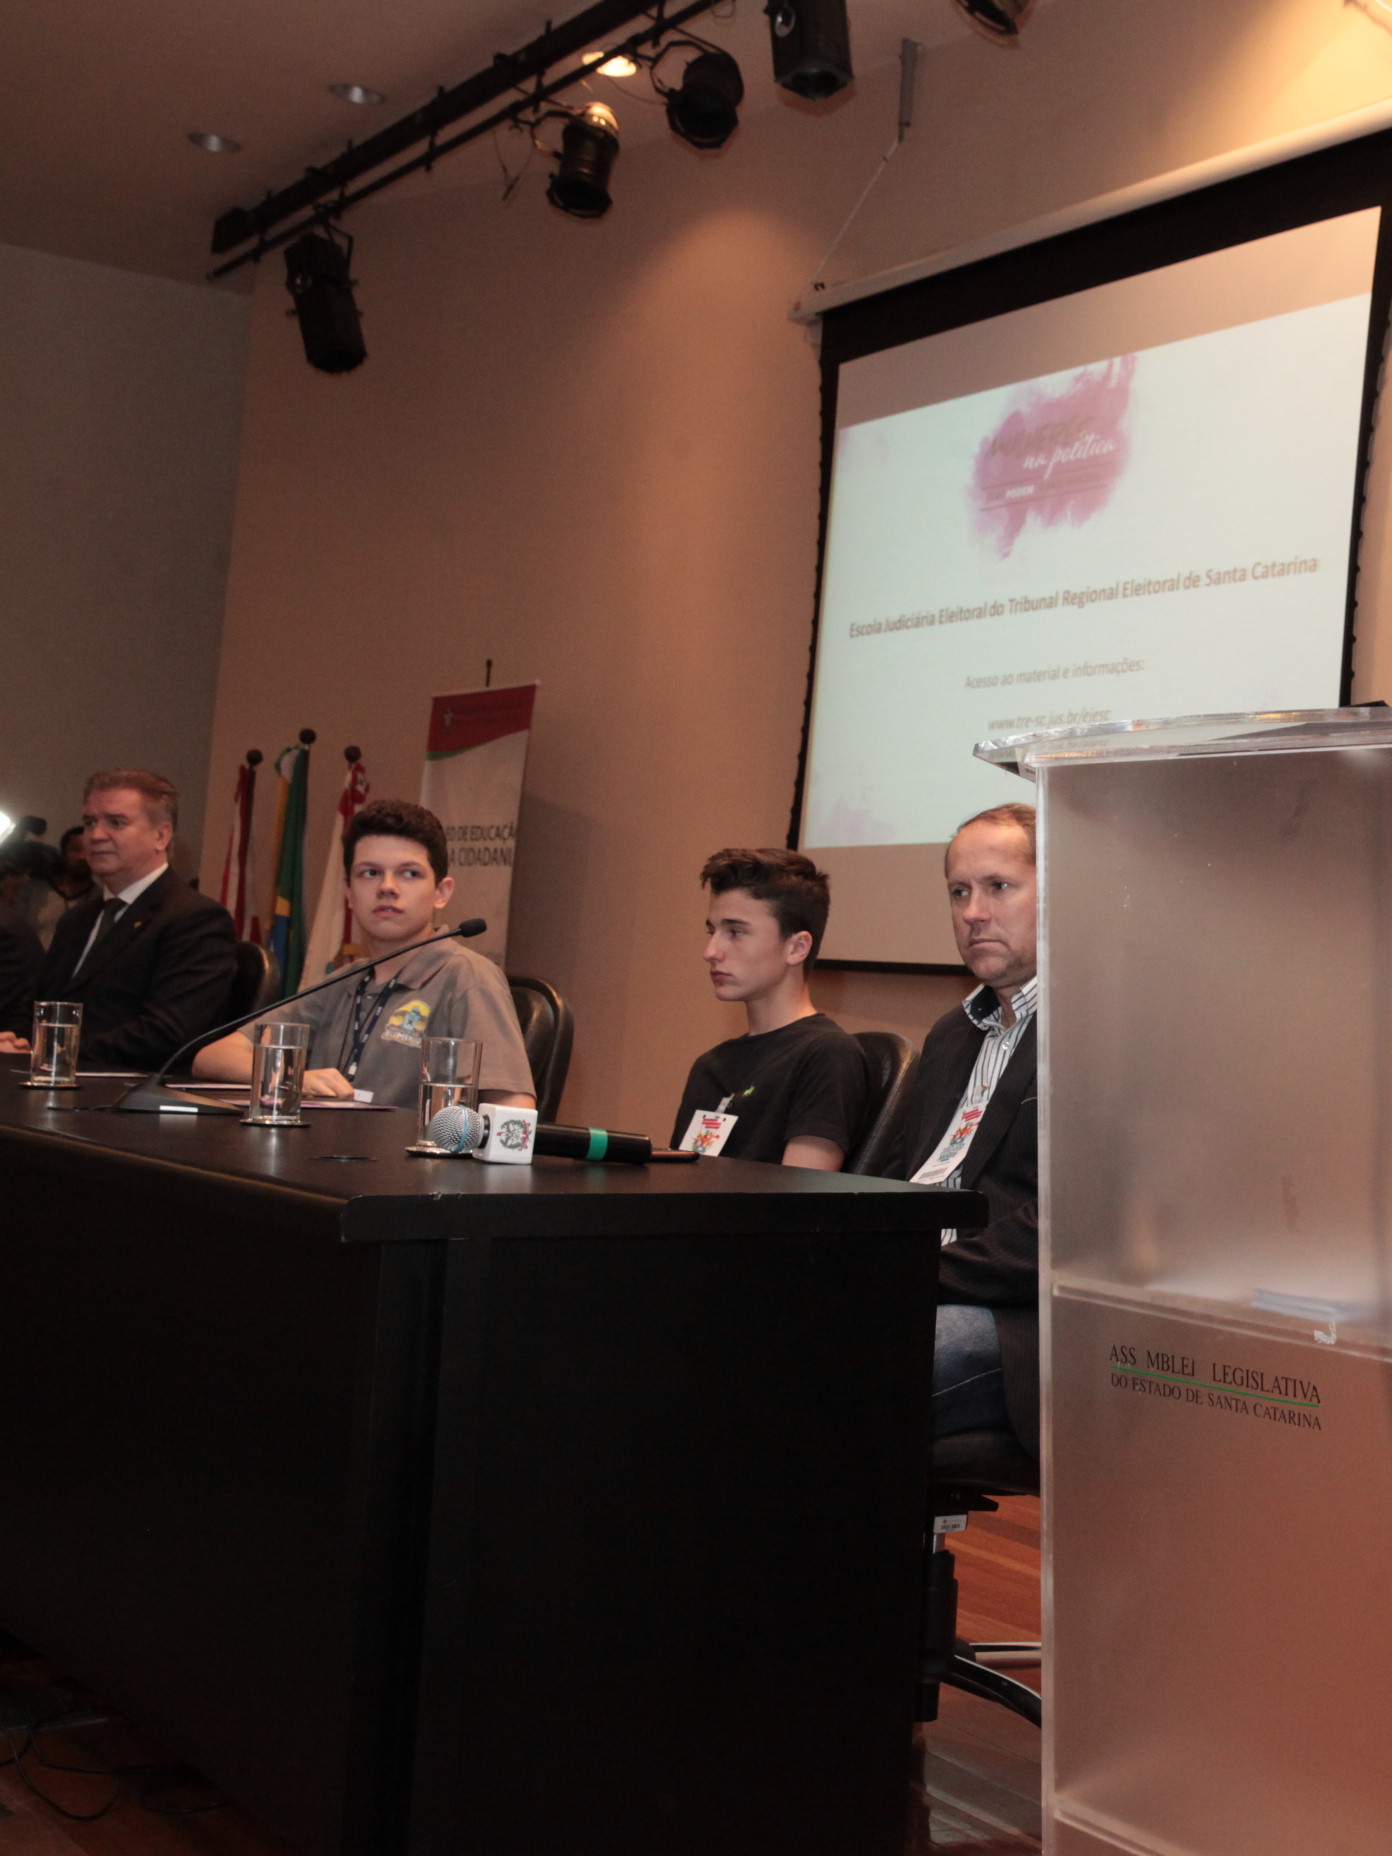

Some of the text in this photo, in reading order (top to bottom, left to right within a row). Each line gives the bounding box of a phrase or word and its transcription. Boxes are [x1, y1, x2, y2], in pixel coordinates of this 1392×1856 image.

[849, 556, 1318, 638] Escola Judiciária Eleitoral do Tribunal Regional Eleitoral de Santa Catarina
[964, 675, 999, 691] Acesso
[1000, 673, 1014, 686] ao
[1016, 665, 1060, 684] material
[1062, 666, 1070, 679] e
[459, 846, 513, 867] CIDADANI
[1111, 1372, 1322, 1431] DO ESTADO DE SANTA CATARINA
[1212, 1362, 1321, 1404] LEGISLATIVA
